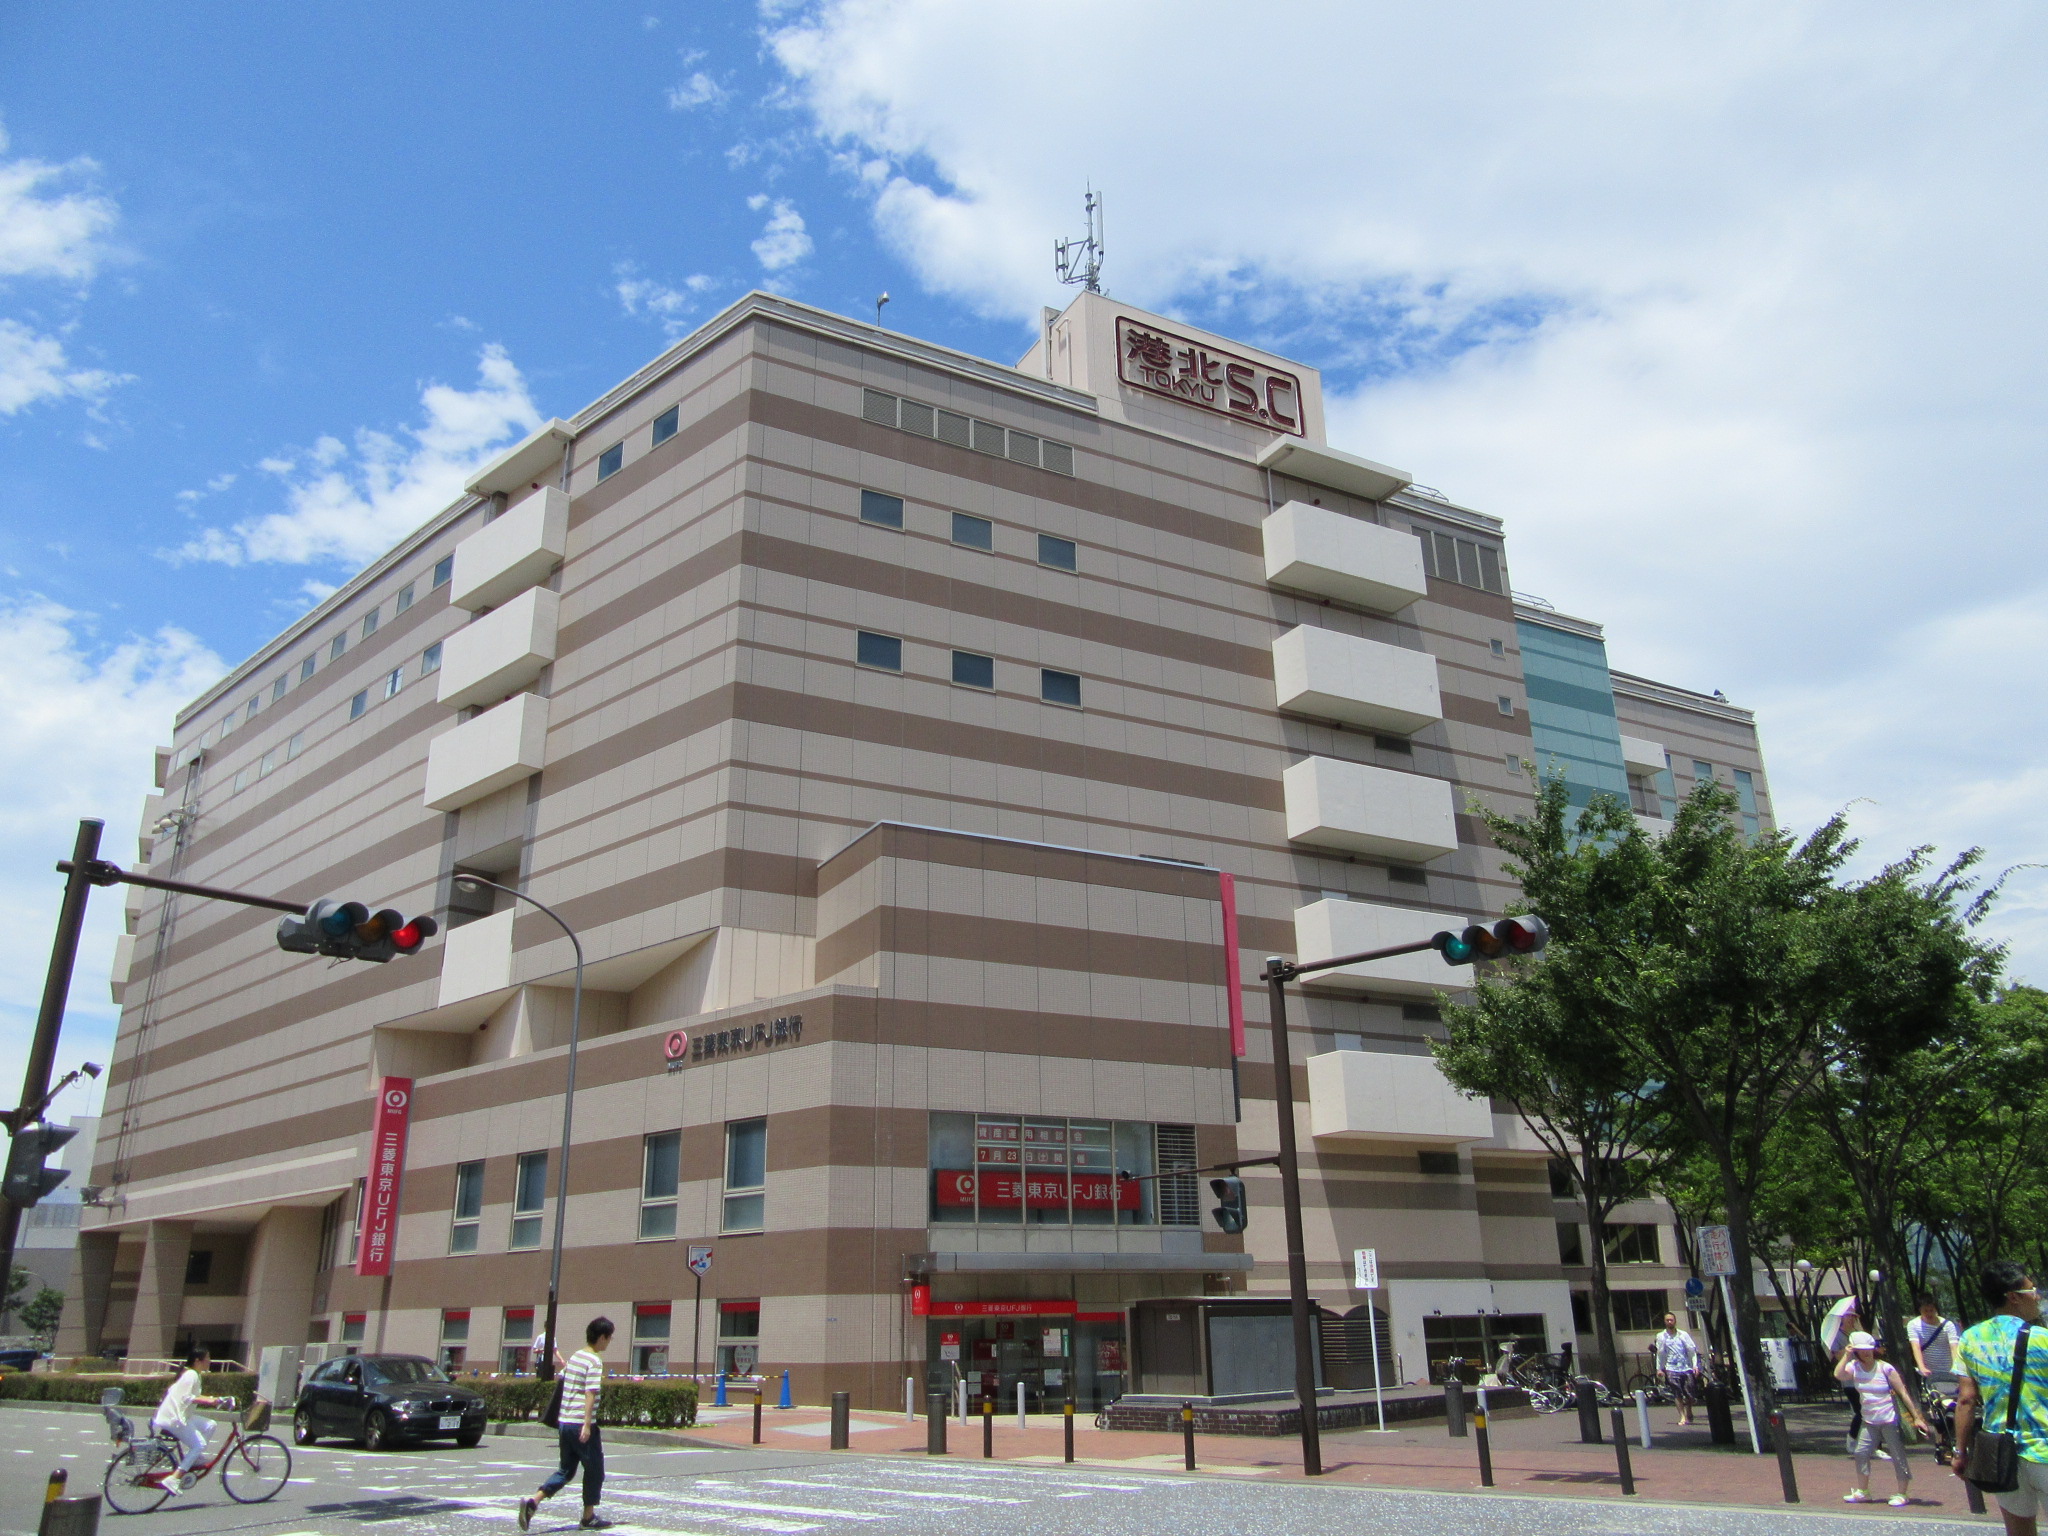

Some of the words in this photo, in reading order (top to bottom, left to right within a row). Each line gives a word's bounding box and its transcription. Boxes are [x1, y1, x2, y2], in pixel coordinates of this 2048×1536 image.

[1138, 364, 1215, 403] TOKYU
[369, 1132, 398, 1263] 三菱東京UFJ銀行
[996, 1181, 1122, 1201] 三菱東京UFJ銀行
